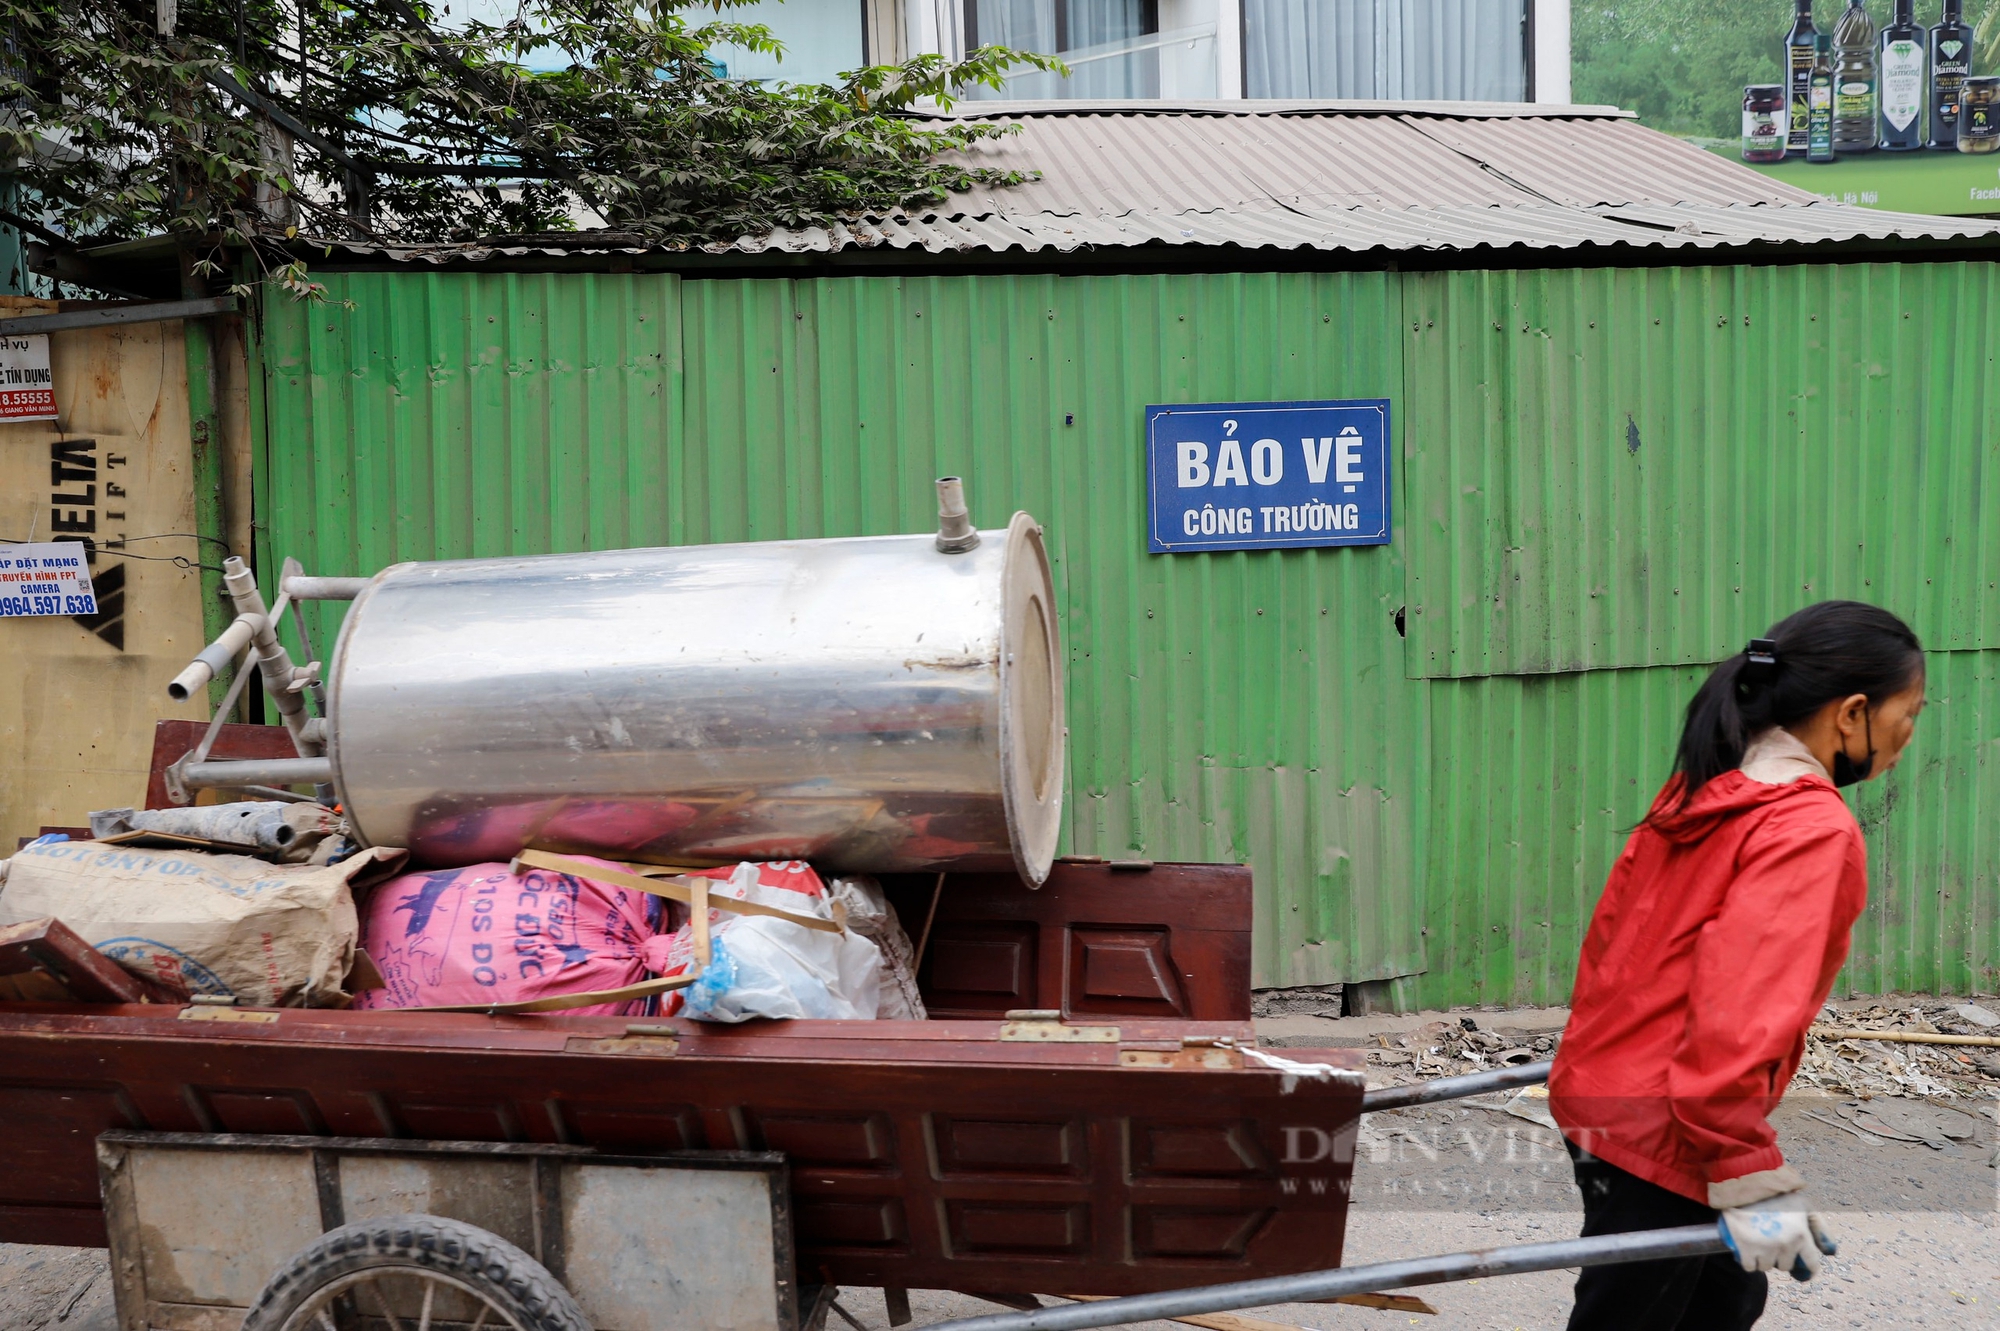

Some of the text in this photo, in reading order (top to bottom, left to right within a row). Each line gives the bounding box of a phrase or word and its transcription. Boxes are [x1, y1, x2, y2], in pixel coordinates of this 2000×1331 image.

[1934, 63, 1968, 76] Diamond
[1861, 191, 1878, 205] Nội
[5, 367, 22, 384] TÍN
[24, 368, 51, 387] DỤNG
[0, 392, 51, 405] 8.55555
[1177, 419, 1364, 493] BẢO VỆ
[1183, 498, 1359, 536] CÔNG TRƯỜNG
[16, 557, 38, 569] ĐẶT
[42, 558, 79, 568] MẠNG
[35, 570, 57, 581] HÌNH
[60, 571, 76, 580] FPT
[20, 584, 61, 594] CAMERA
